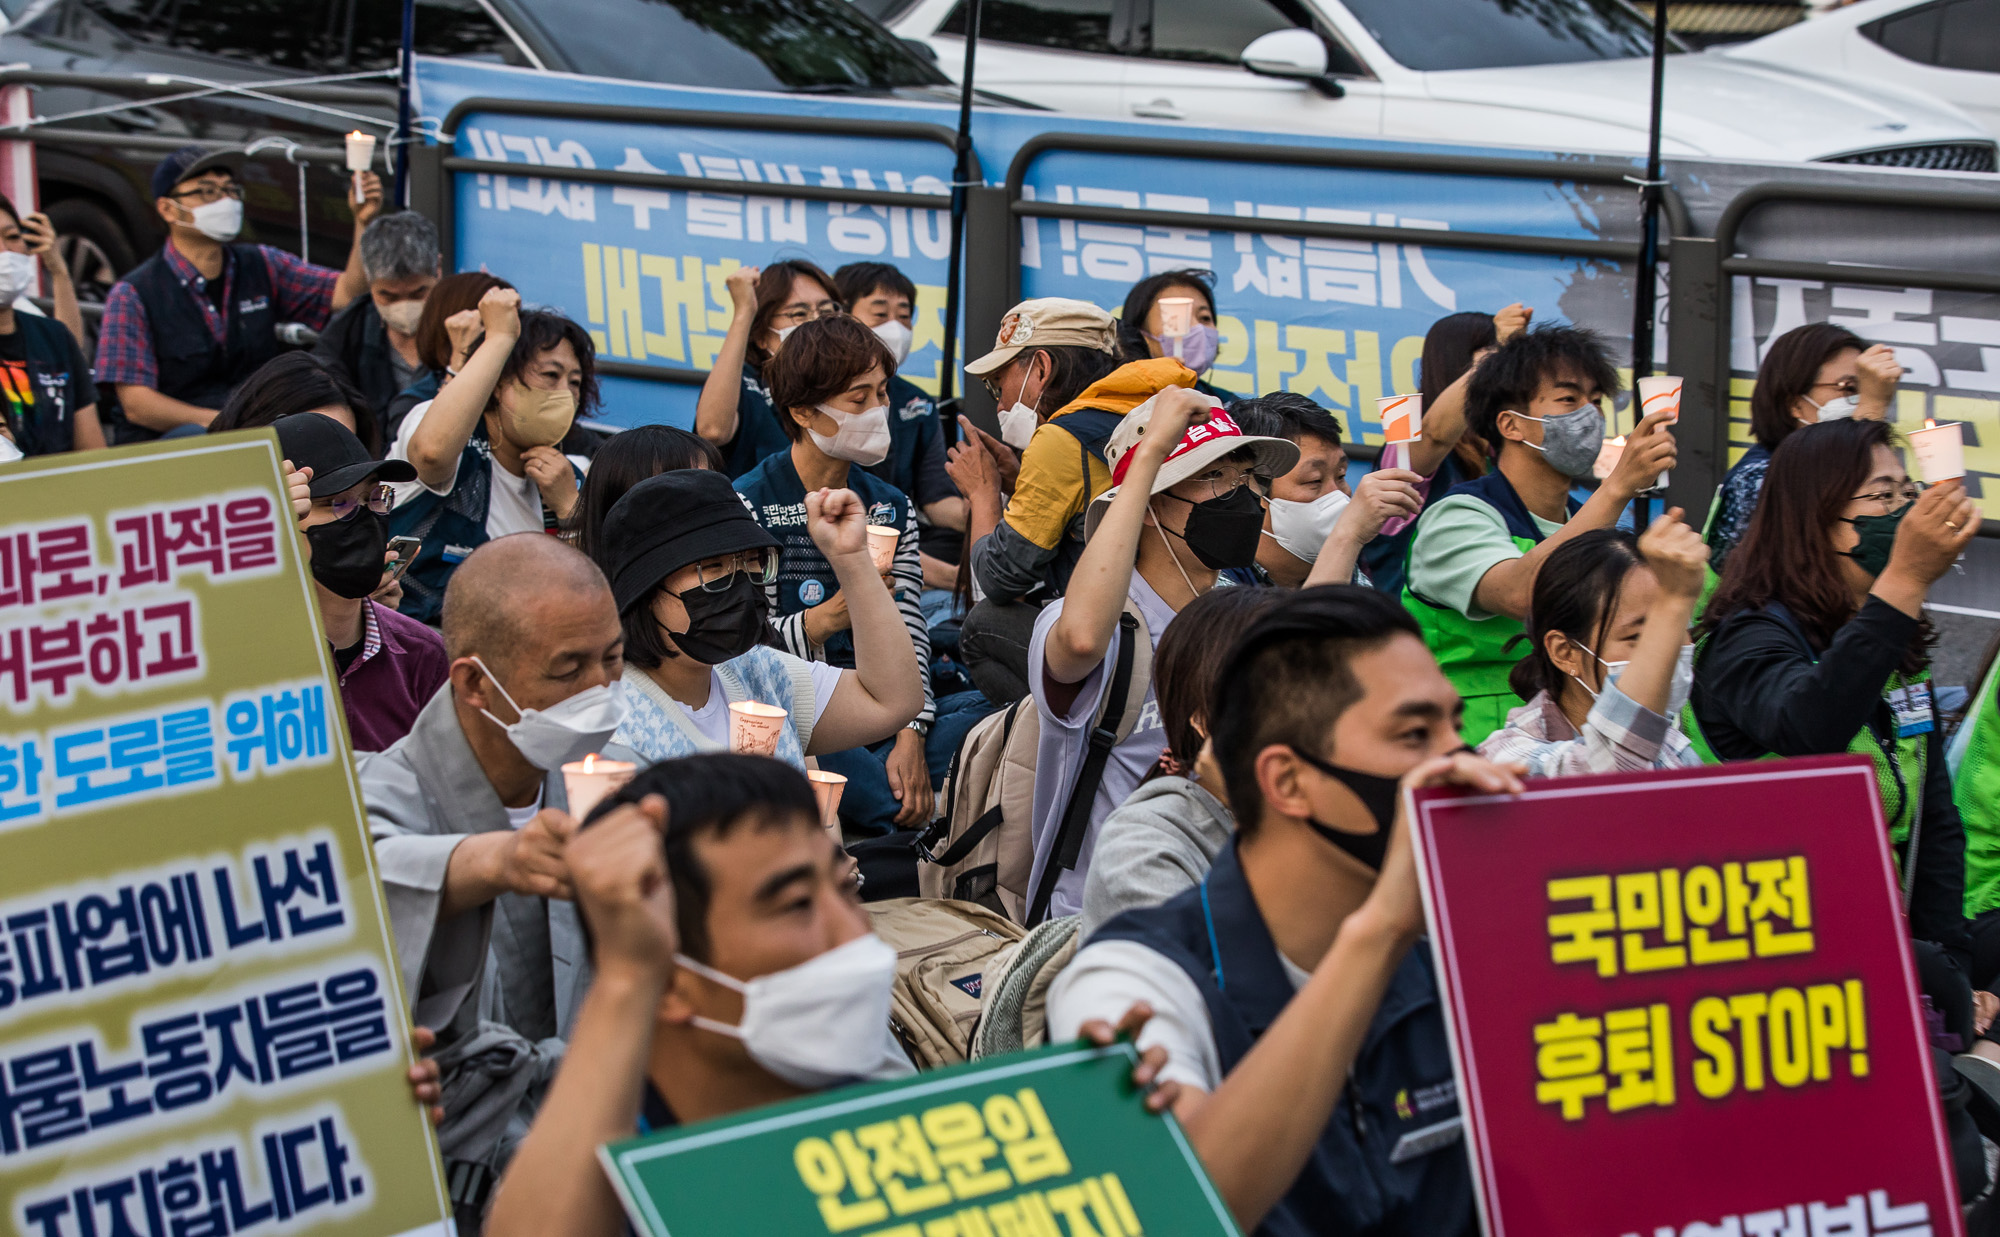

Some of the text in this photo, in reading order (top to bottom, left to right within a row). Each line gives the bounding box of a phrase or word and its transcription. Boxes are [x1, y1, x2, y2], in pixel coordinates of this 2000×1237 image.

[116, 496, 277, 588] 과적을
[54, 706, 216, 809] 도로를
[226, 685, 329, 771] 위해
[0, 842, 345, 1008] 파업에 나선
[1548, 856, 1815, 977] 국민안전
[1534, 980, 1870, 1120] 후퇴 STOP!
[25, 1117, 364, 1237] 지지합니다.
[795, 1088, 1071, 1232] 안전운임
